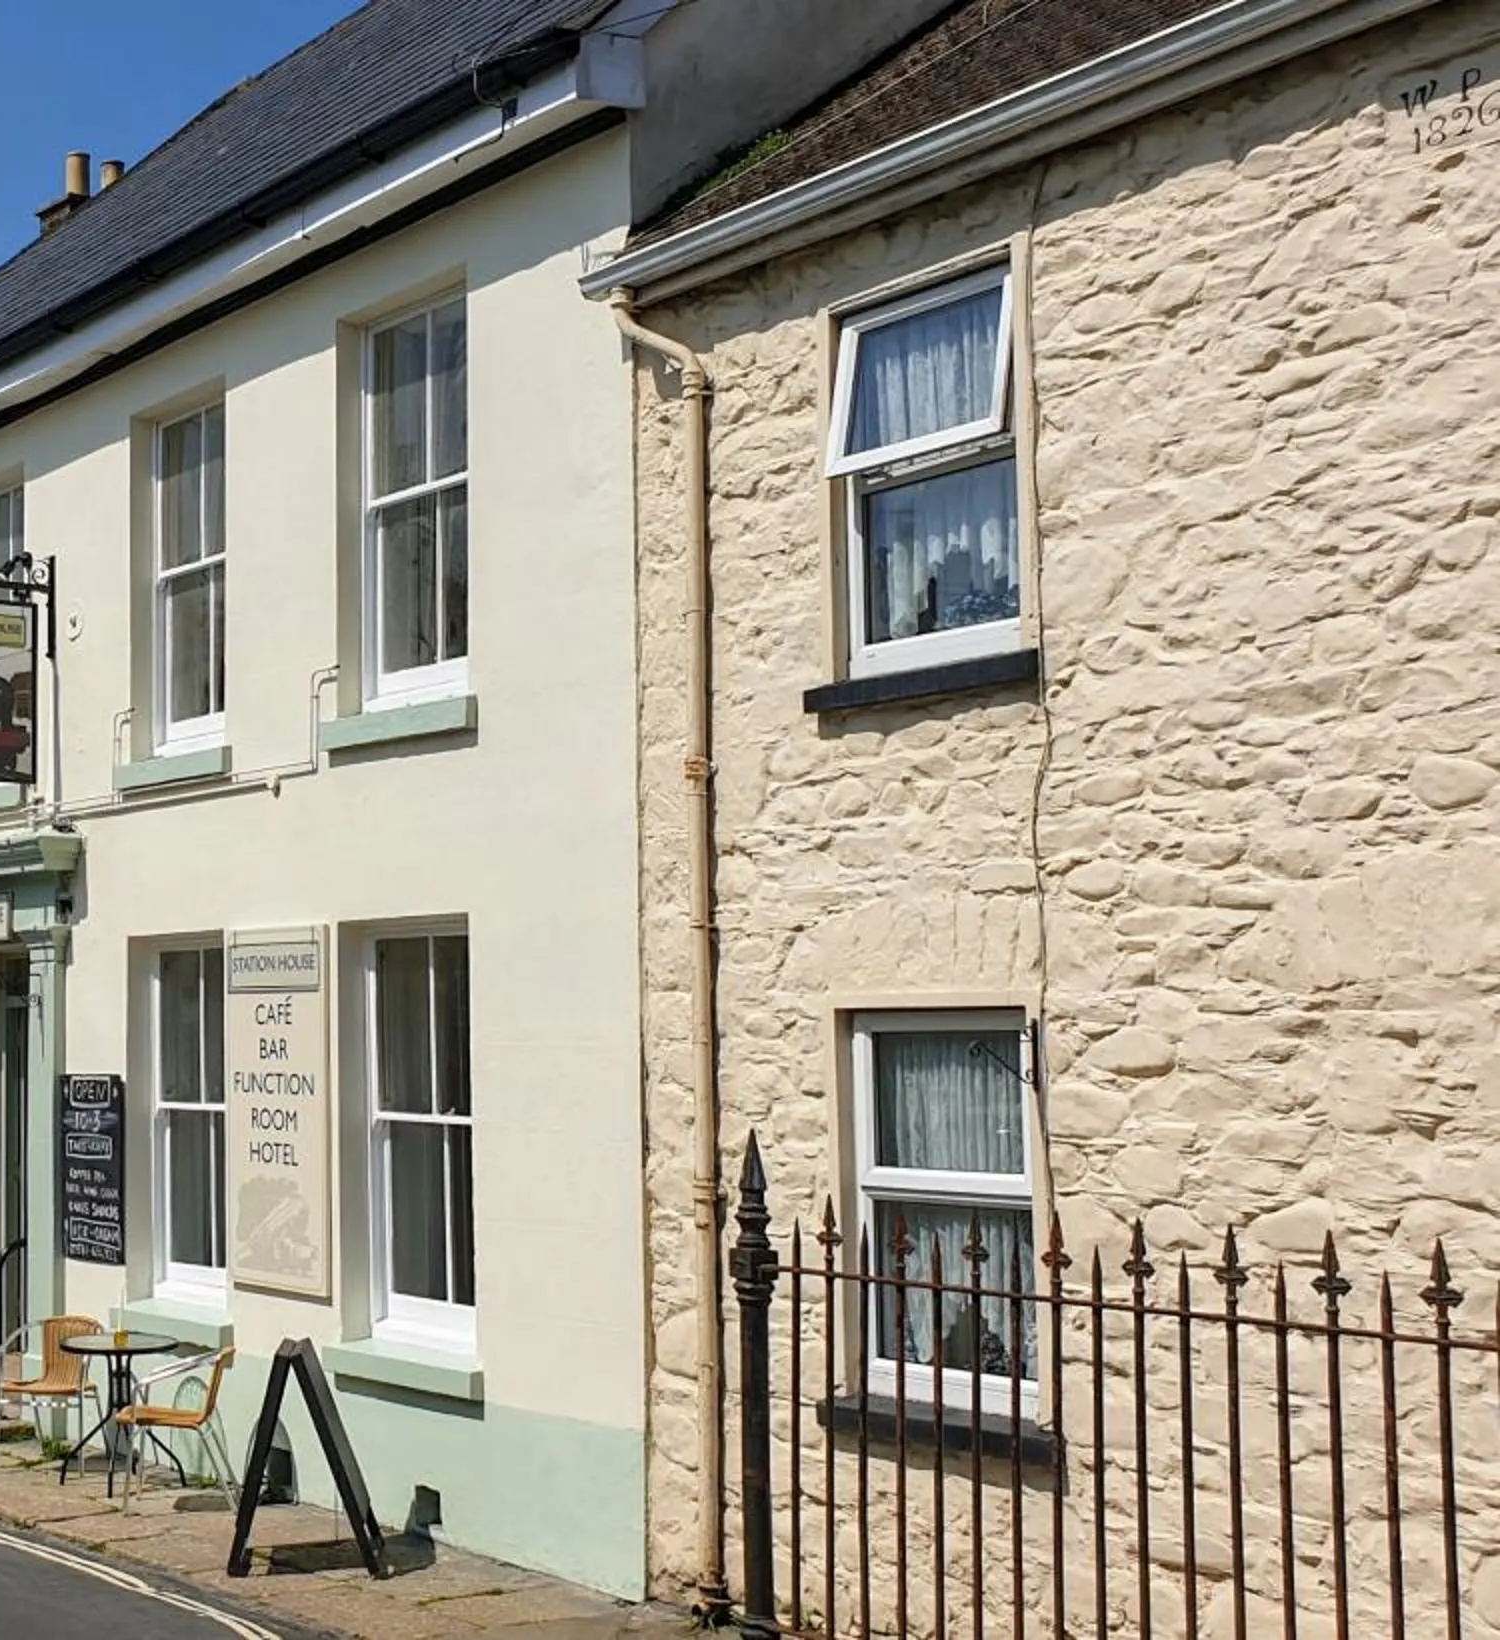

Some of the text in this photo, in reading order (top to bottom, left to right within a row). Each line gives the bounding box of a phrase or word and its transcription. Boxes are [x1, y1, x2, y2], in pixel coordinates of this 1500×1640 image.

[1400, 67, 1481, 118] W P
[1412, 89, 1500, 155] 1826
[233, 953, 316, 973] STATION HOUSE
[254, 996, 293, 1027] CAFÉ
[258, 1038, 289, 1061] BAR
[75, 1081, 107, 1101] OPEN
[234, 1071, 316, 1097] FUNCTION
[251, 1108, 299, 1133] ROOM
[249, 1141, 299, 1167] HOTEL
